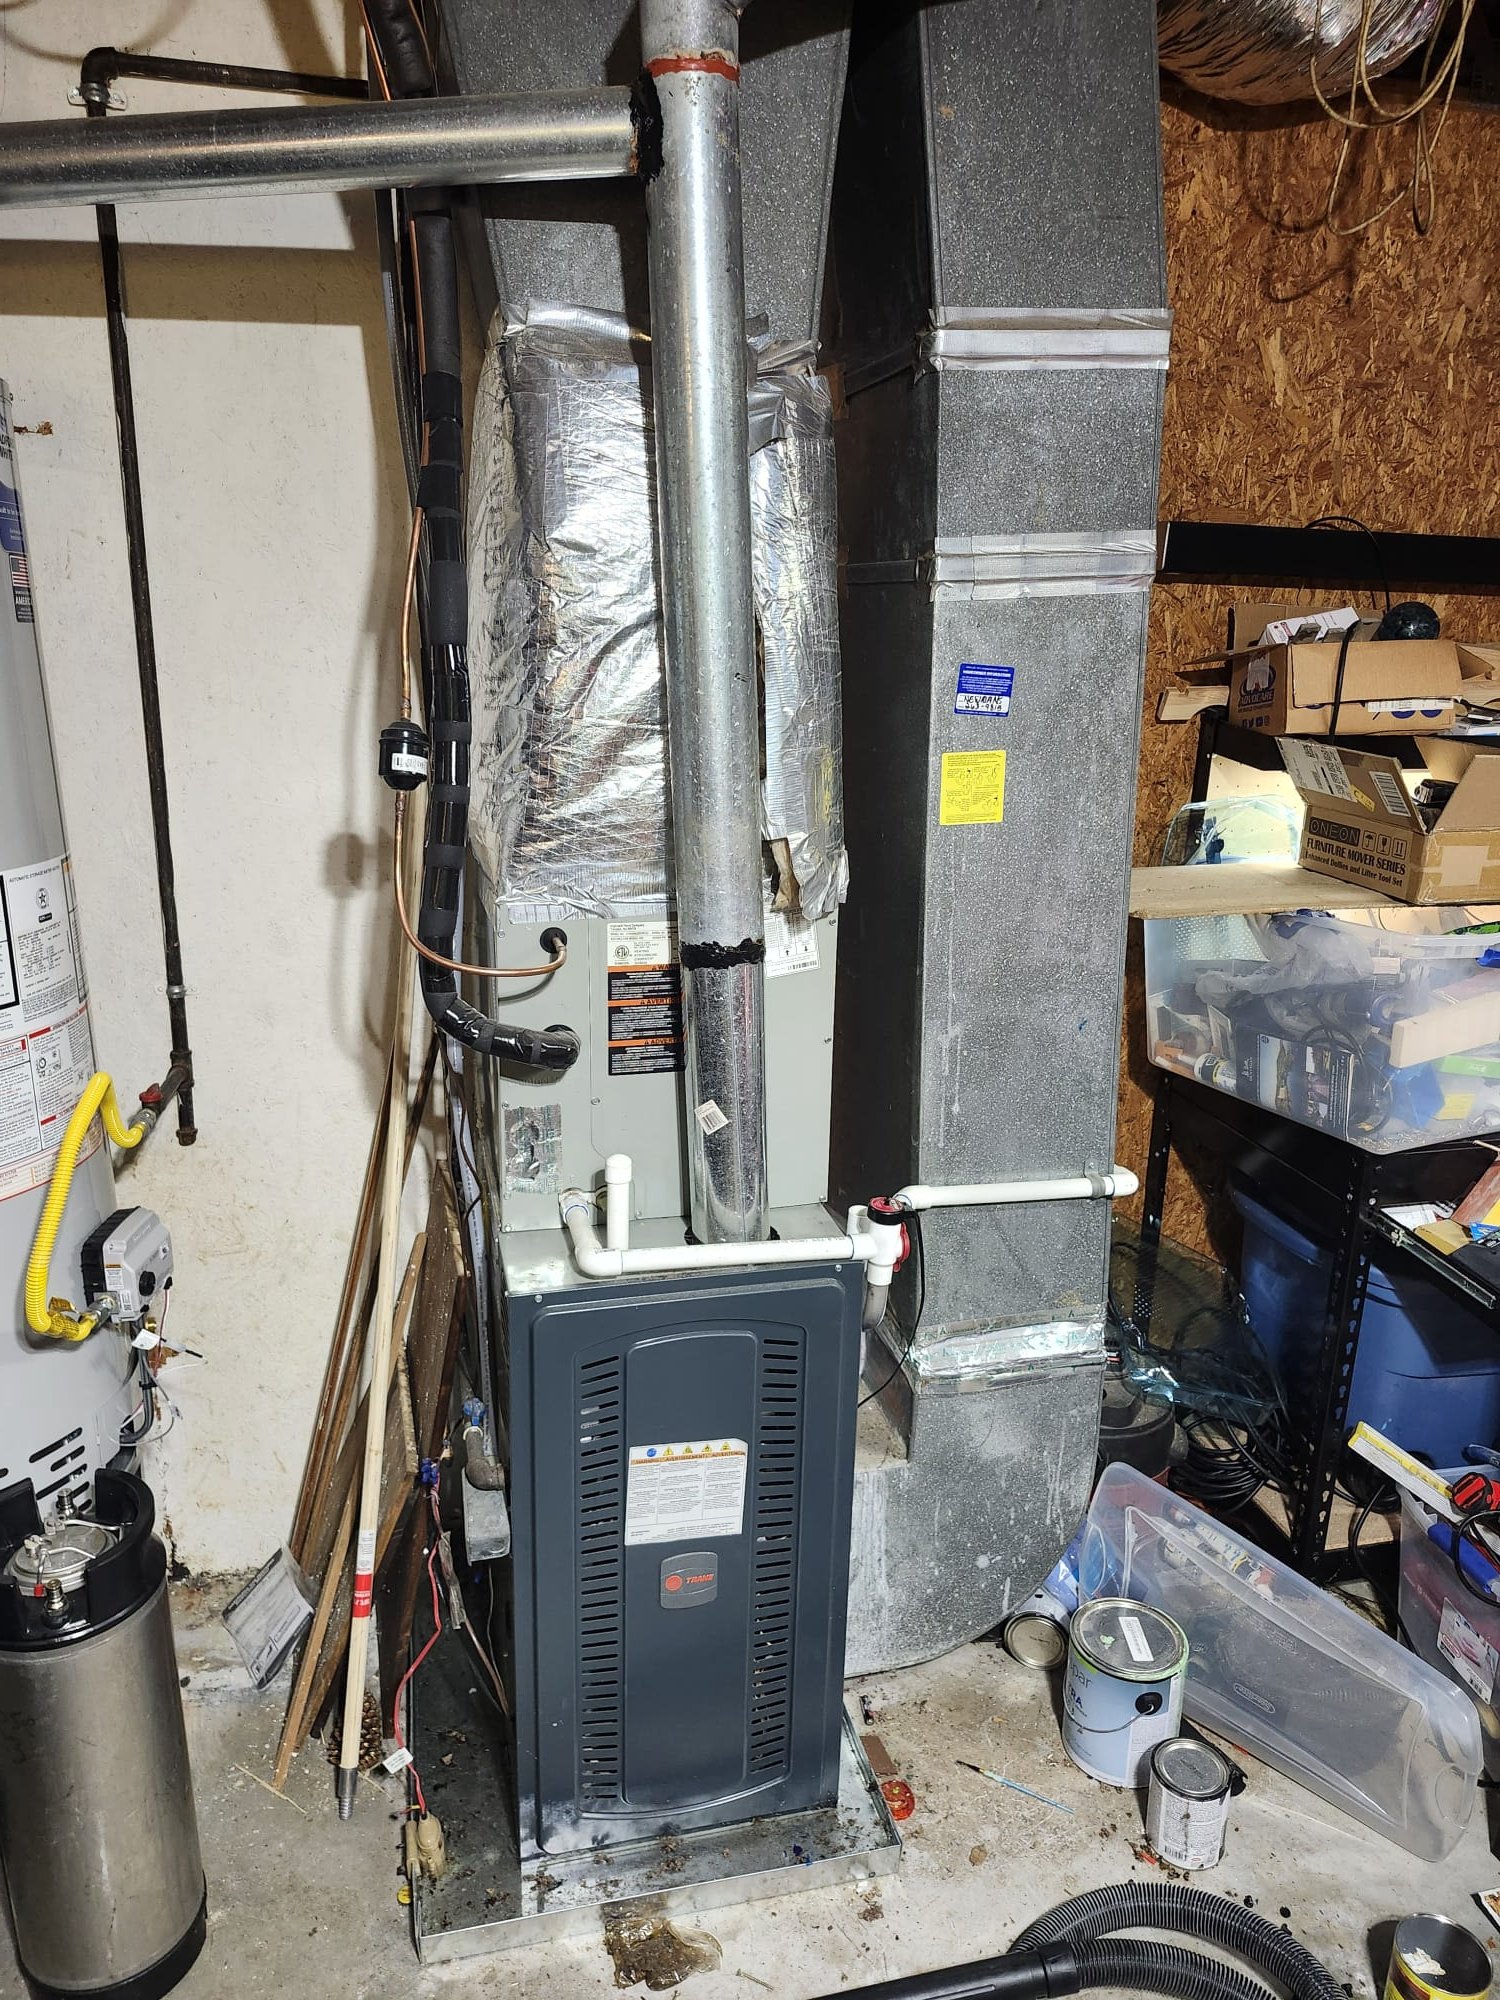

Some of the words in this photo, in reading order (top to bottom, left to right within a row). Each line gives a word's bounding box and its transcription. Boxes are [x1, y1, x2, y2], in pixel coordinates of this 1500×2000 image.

[1310, 819, 1359, 842] ONEON
[1305, 850, 1330, 865] Enhanced
[1330, 858, 1349, 871] Dollies
[1349, 866, 1361, 875] and
[1378, 873, 1392, 884] Tool
[1391, 876, 1403, 887] Set
[1307, 837, 1347, 859] FURNITURE
[1347, 849, 1375, 867] MOVER
[1375, 857, 1406, 876] SERIES
